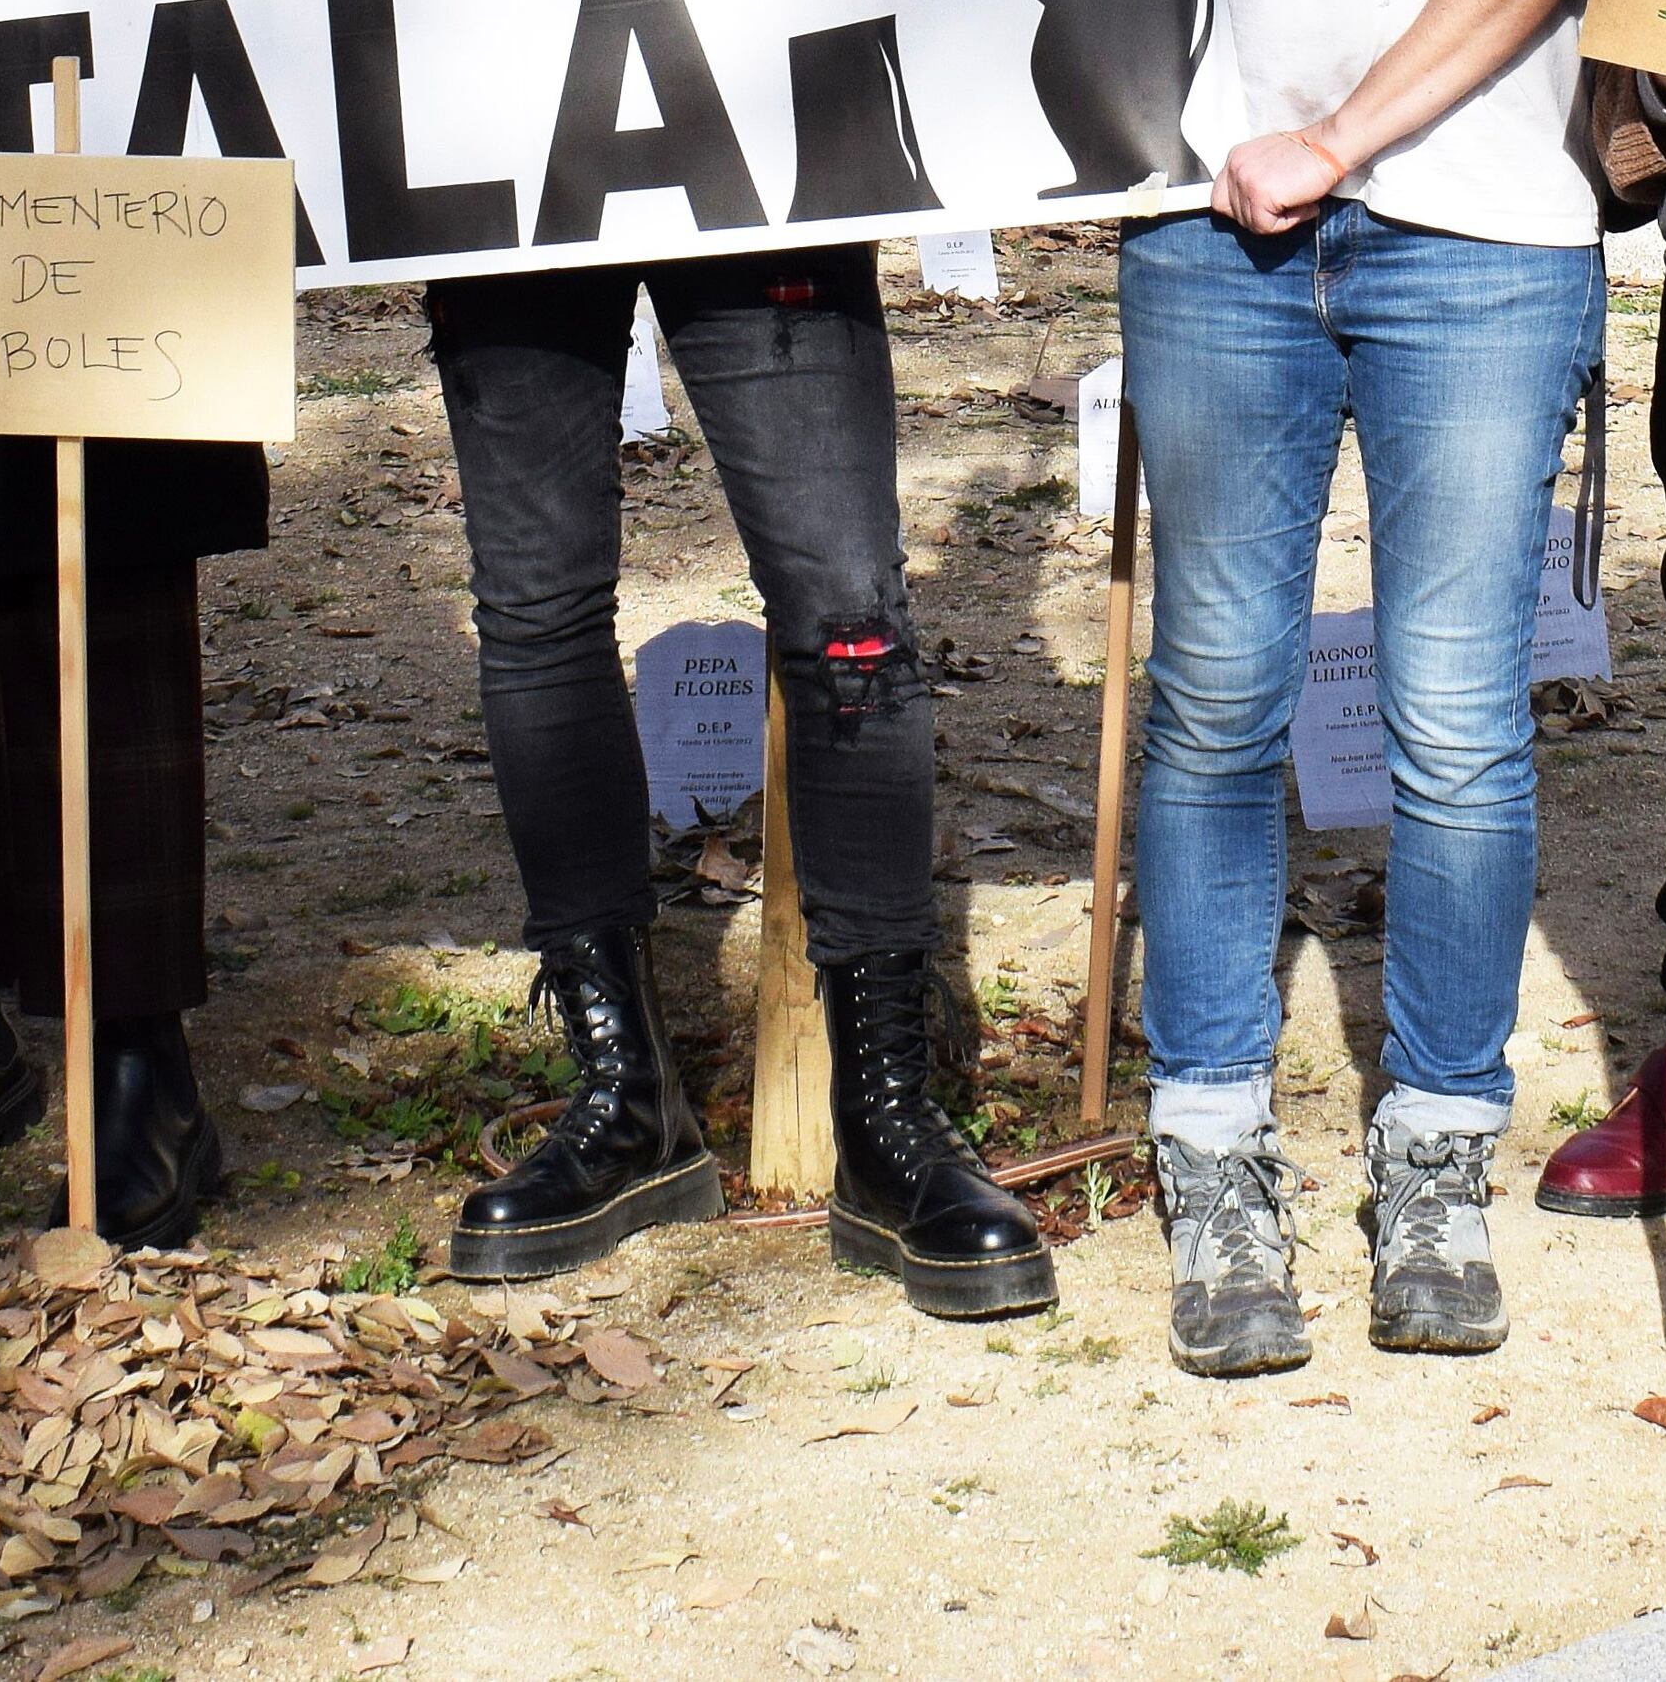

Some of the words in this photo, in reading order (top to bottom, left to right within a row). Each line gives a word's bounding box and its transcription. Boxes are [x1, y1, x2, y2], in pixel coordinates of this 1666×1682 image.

[10, 253, 96, 305] DE
[683, 658, 739, 675] PEPA
[1312, 663, 1378, 683] LILIFLO
[673, 679, 754, 697] FLORES
[1342, 704, 1376, 718] D.E.P
[696, 722, 733, 735] D.E.P
